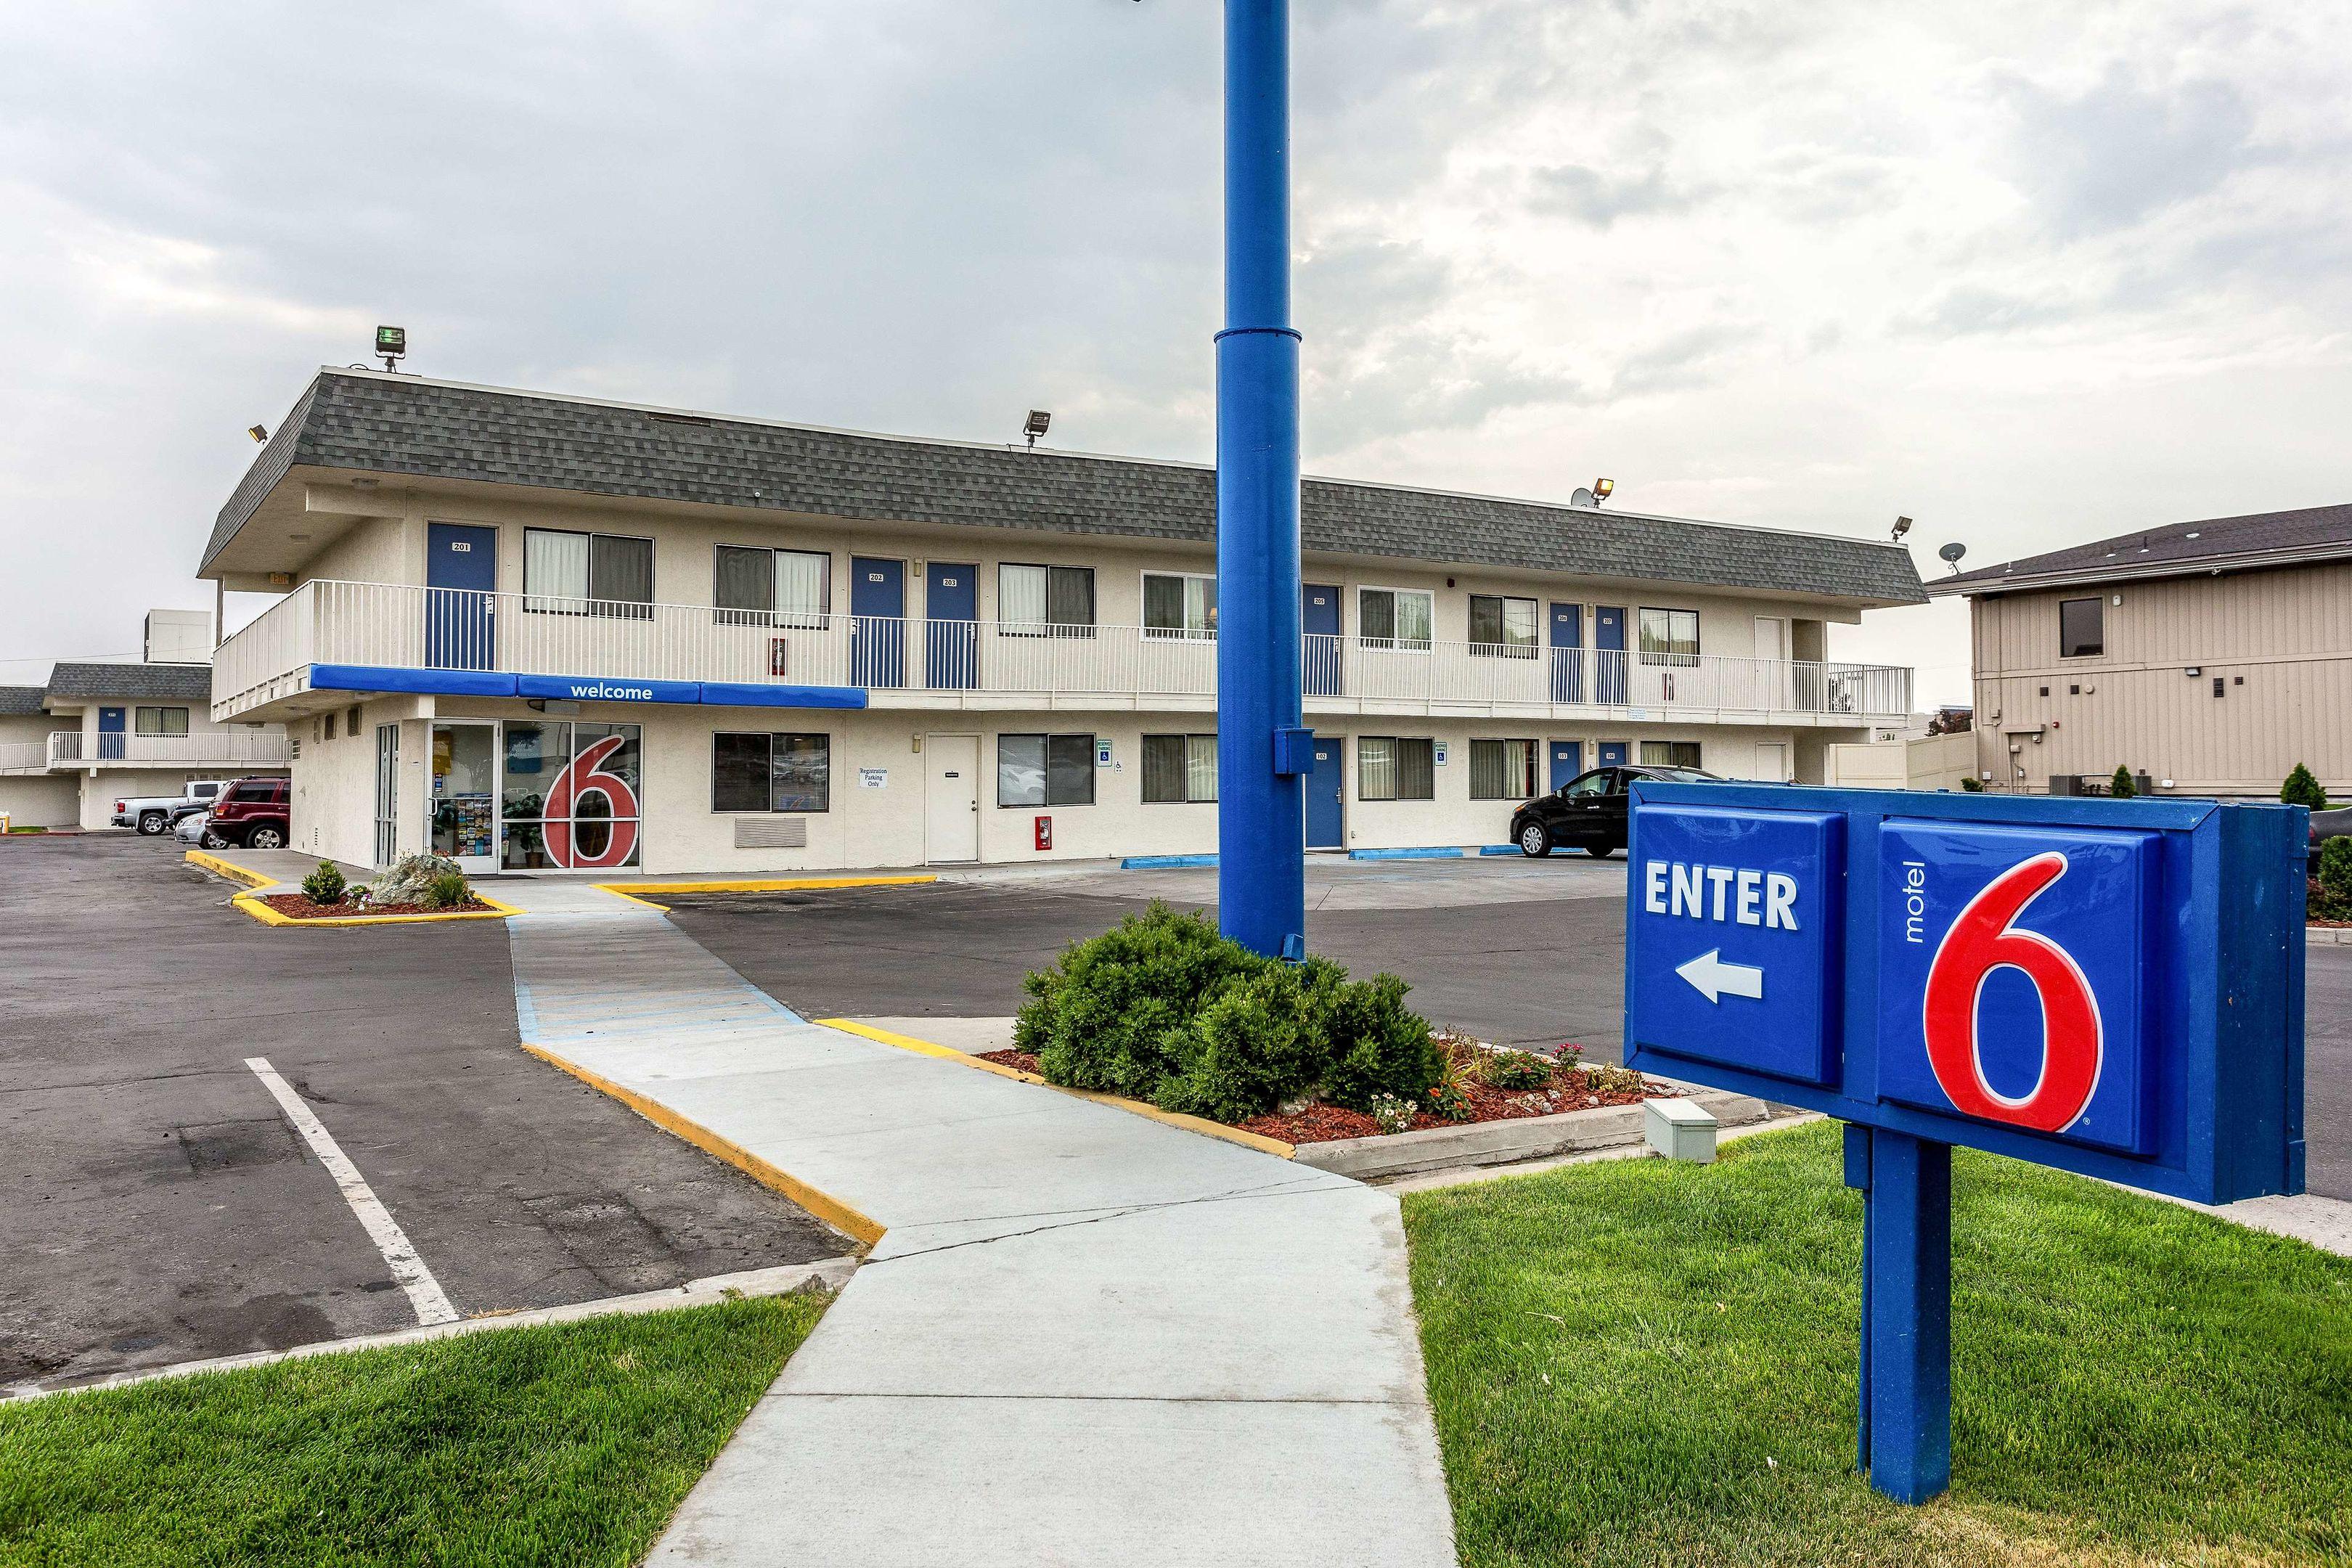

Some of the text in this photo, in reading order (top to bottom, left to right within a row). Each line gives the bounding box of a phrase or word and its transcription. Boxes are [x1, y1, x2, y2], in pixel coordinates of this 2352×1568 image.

[571, 682, 653, 700] welcome
[542, 734, 639, 868] 6
[1646, 860, 1800, 931] ENTER
[1903, 861, 1925, 944] motel
[1923, 852, 2104, 1133] 6
